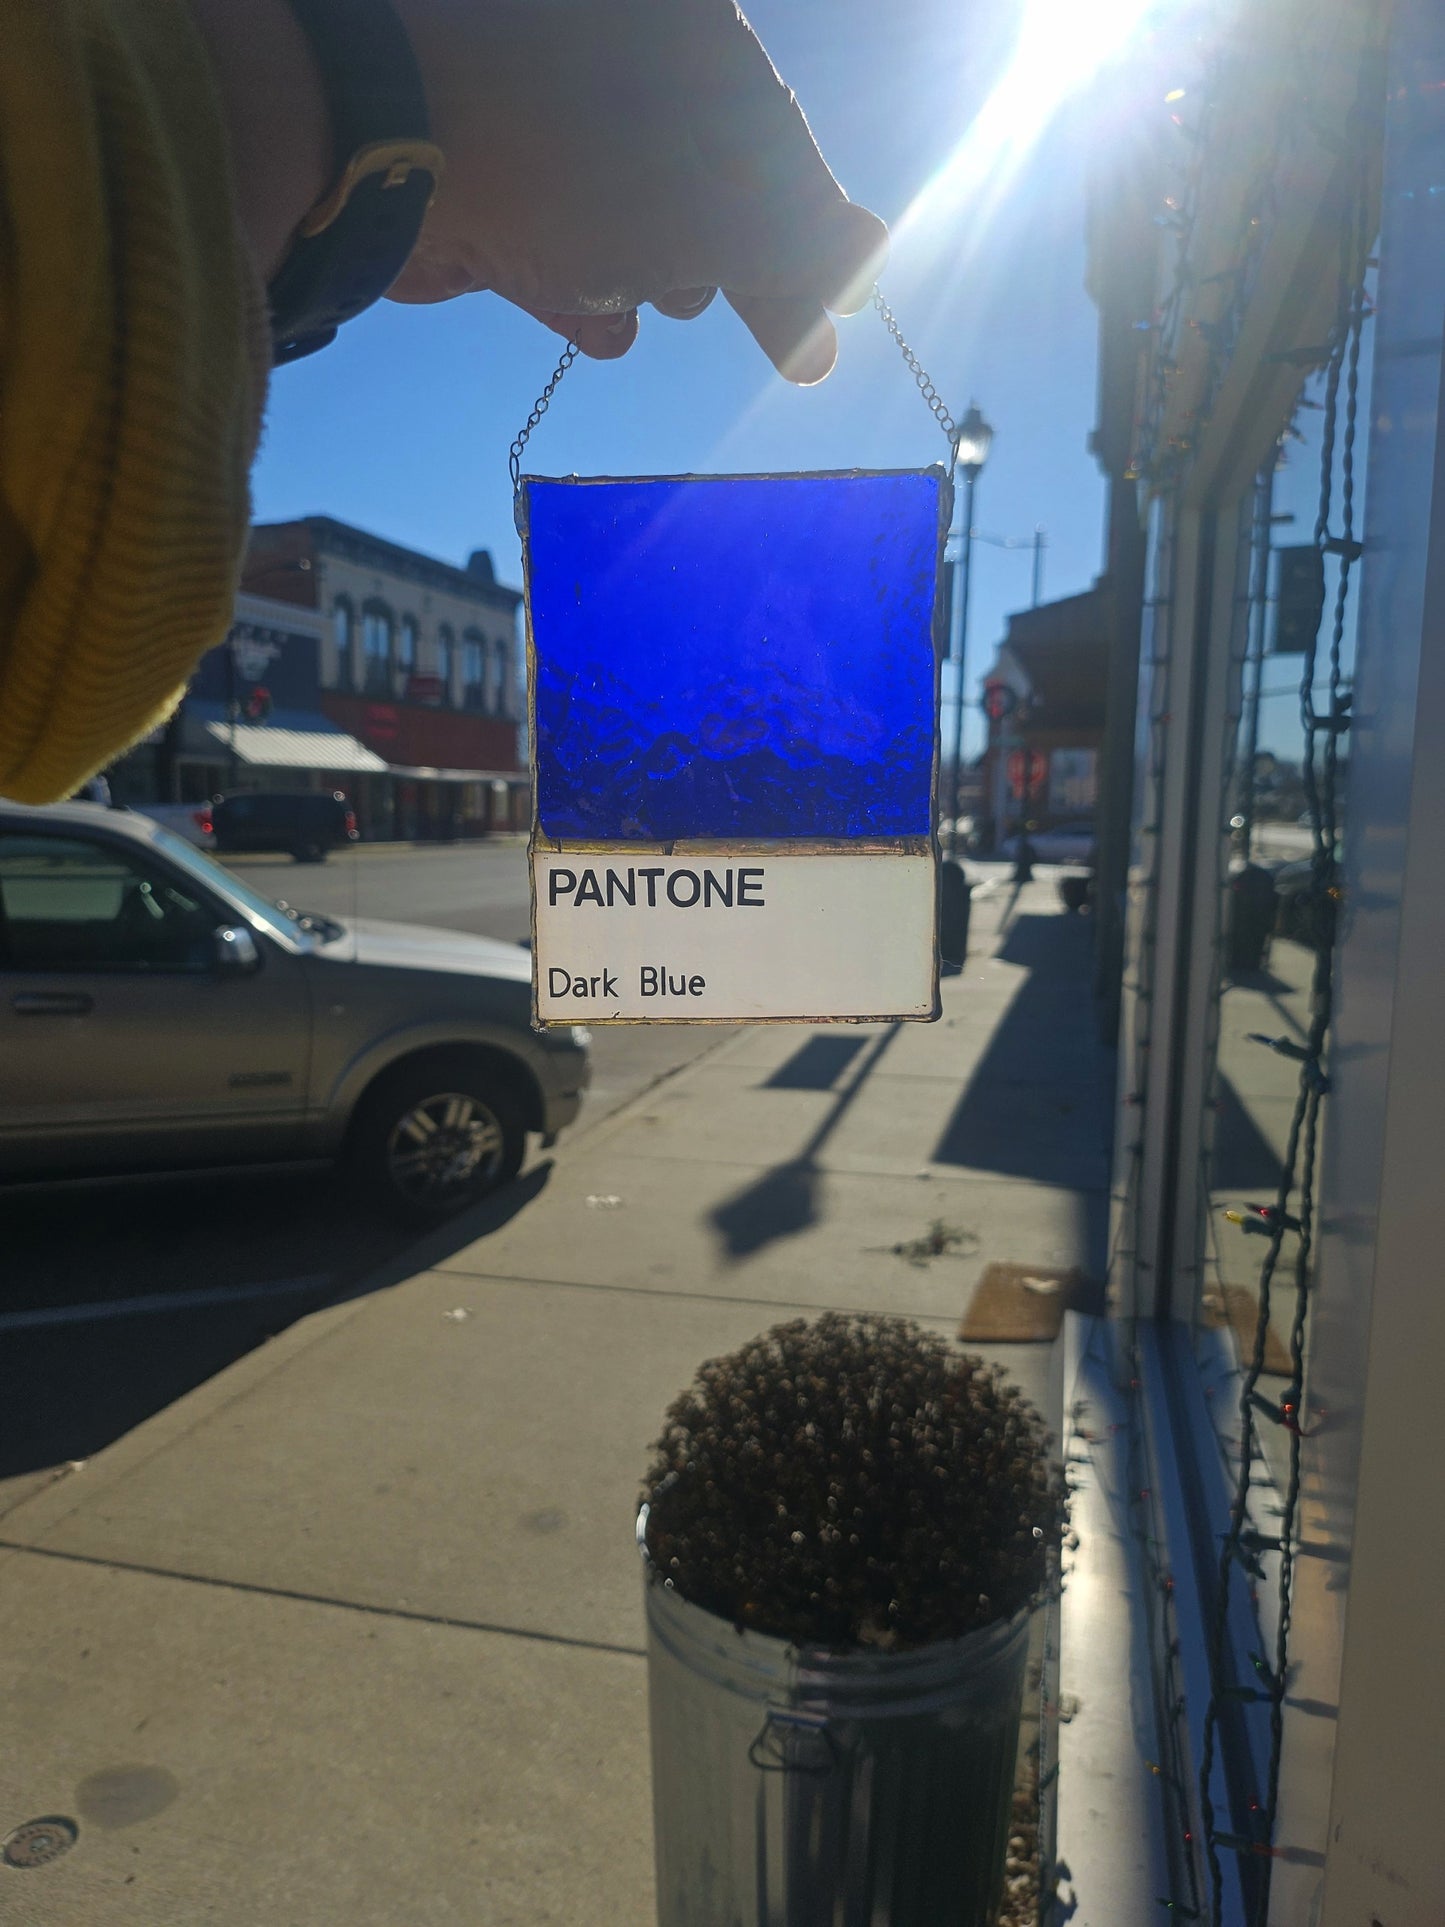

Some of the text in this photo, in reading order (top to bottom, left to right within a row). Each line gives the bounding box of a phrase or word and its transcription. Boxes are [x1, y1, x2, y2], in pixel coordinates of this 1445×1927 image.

[549, 868, 764, 907] PANTONE
[549, 967, 705, 997] Dark Blue
